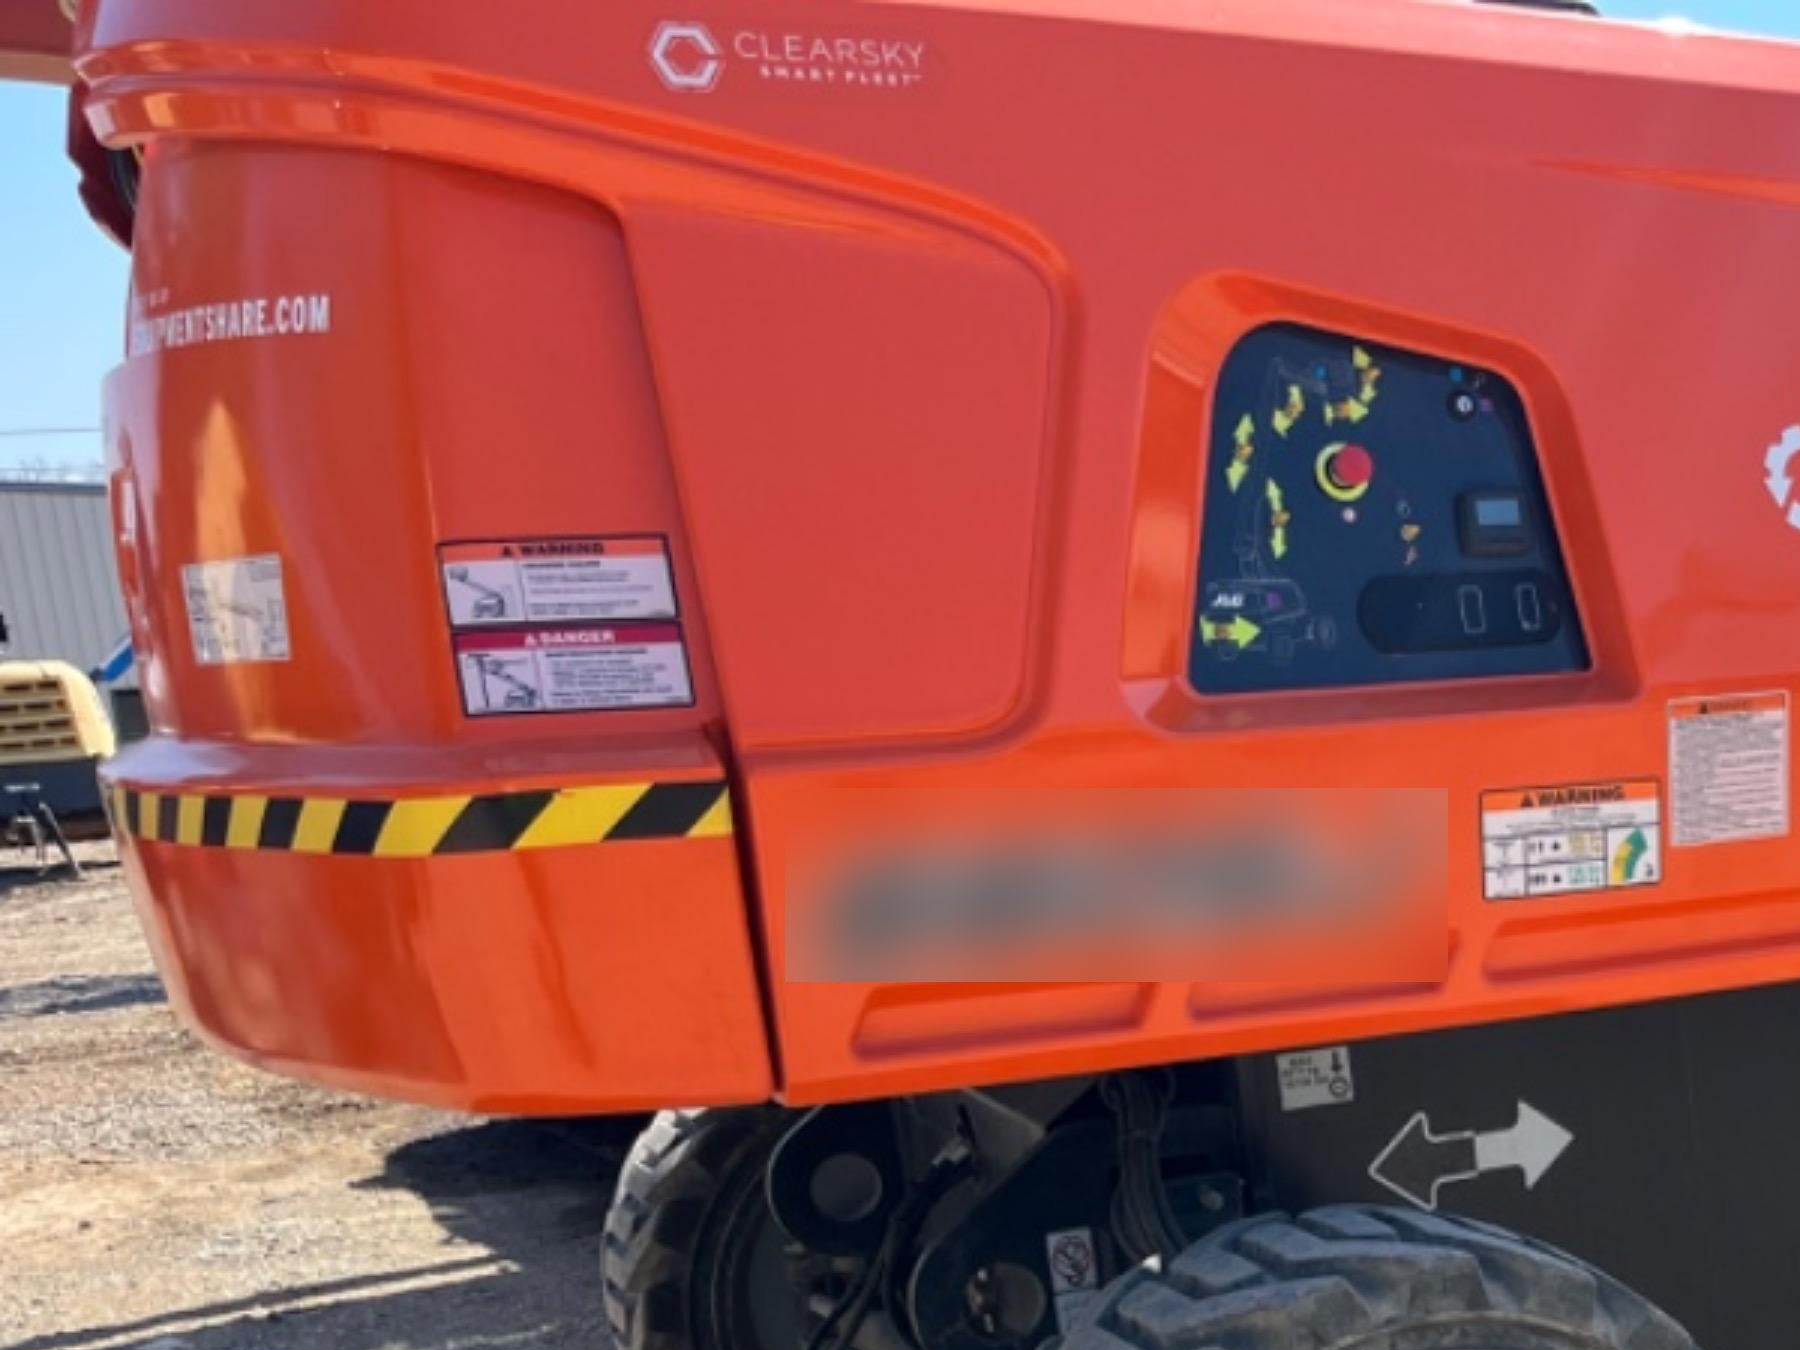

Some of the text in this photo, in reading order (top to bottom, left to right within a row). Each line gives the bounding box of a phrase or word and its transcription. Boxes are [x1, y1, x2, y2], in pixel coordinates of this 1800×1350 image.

[733, 31, 924, 68] CLEARSKY
[758, 64, 836, 82] SMART
[520, 542, 605, 557] WARNING
[539, 629, 616, 645] DANGER
[1537, 784, 1626, 807] WARNING
